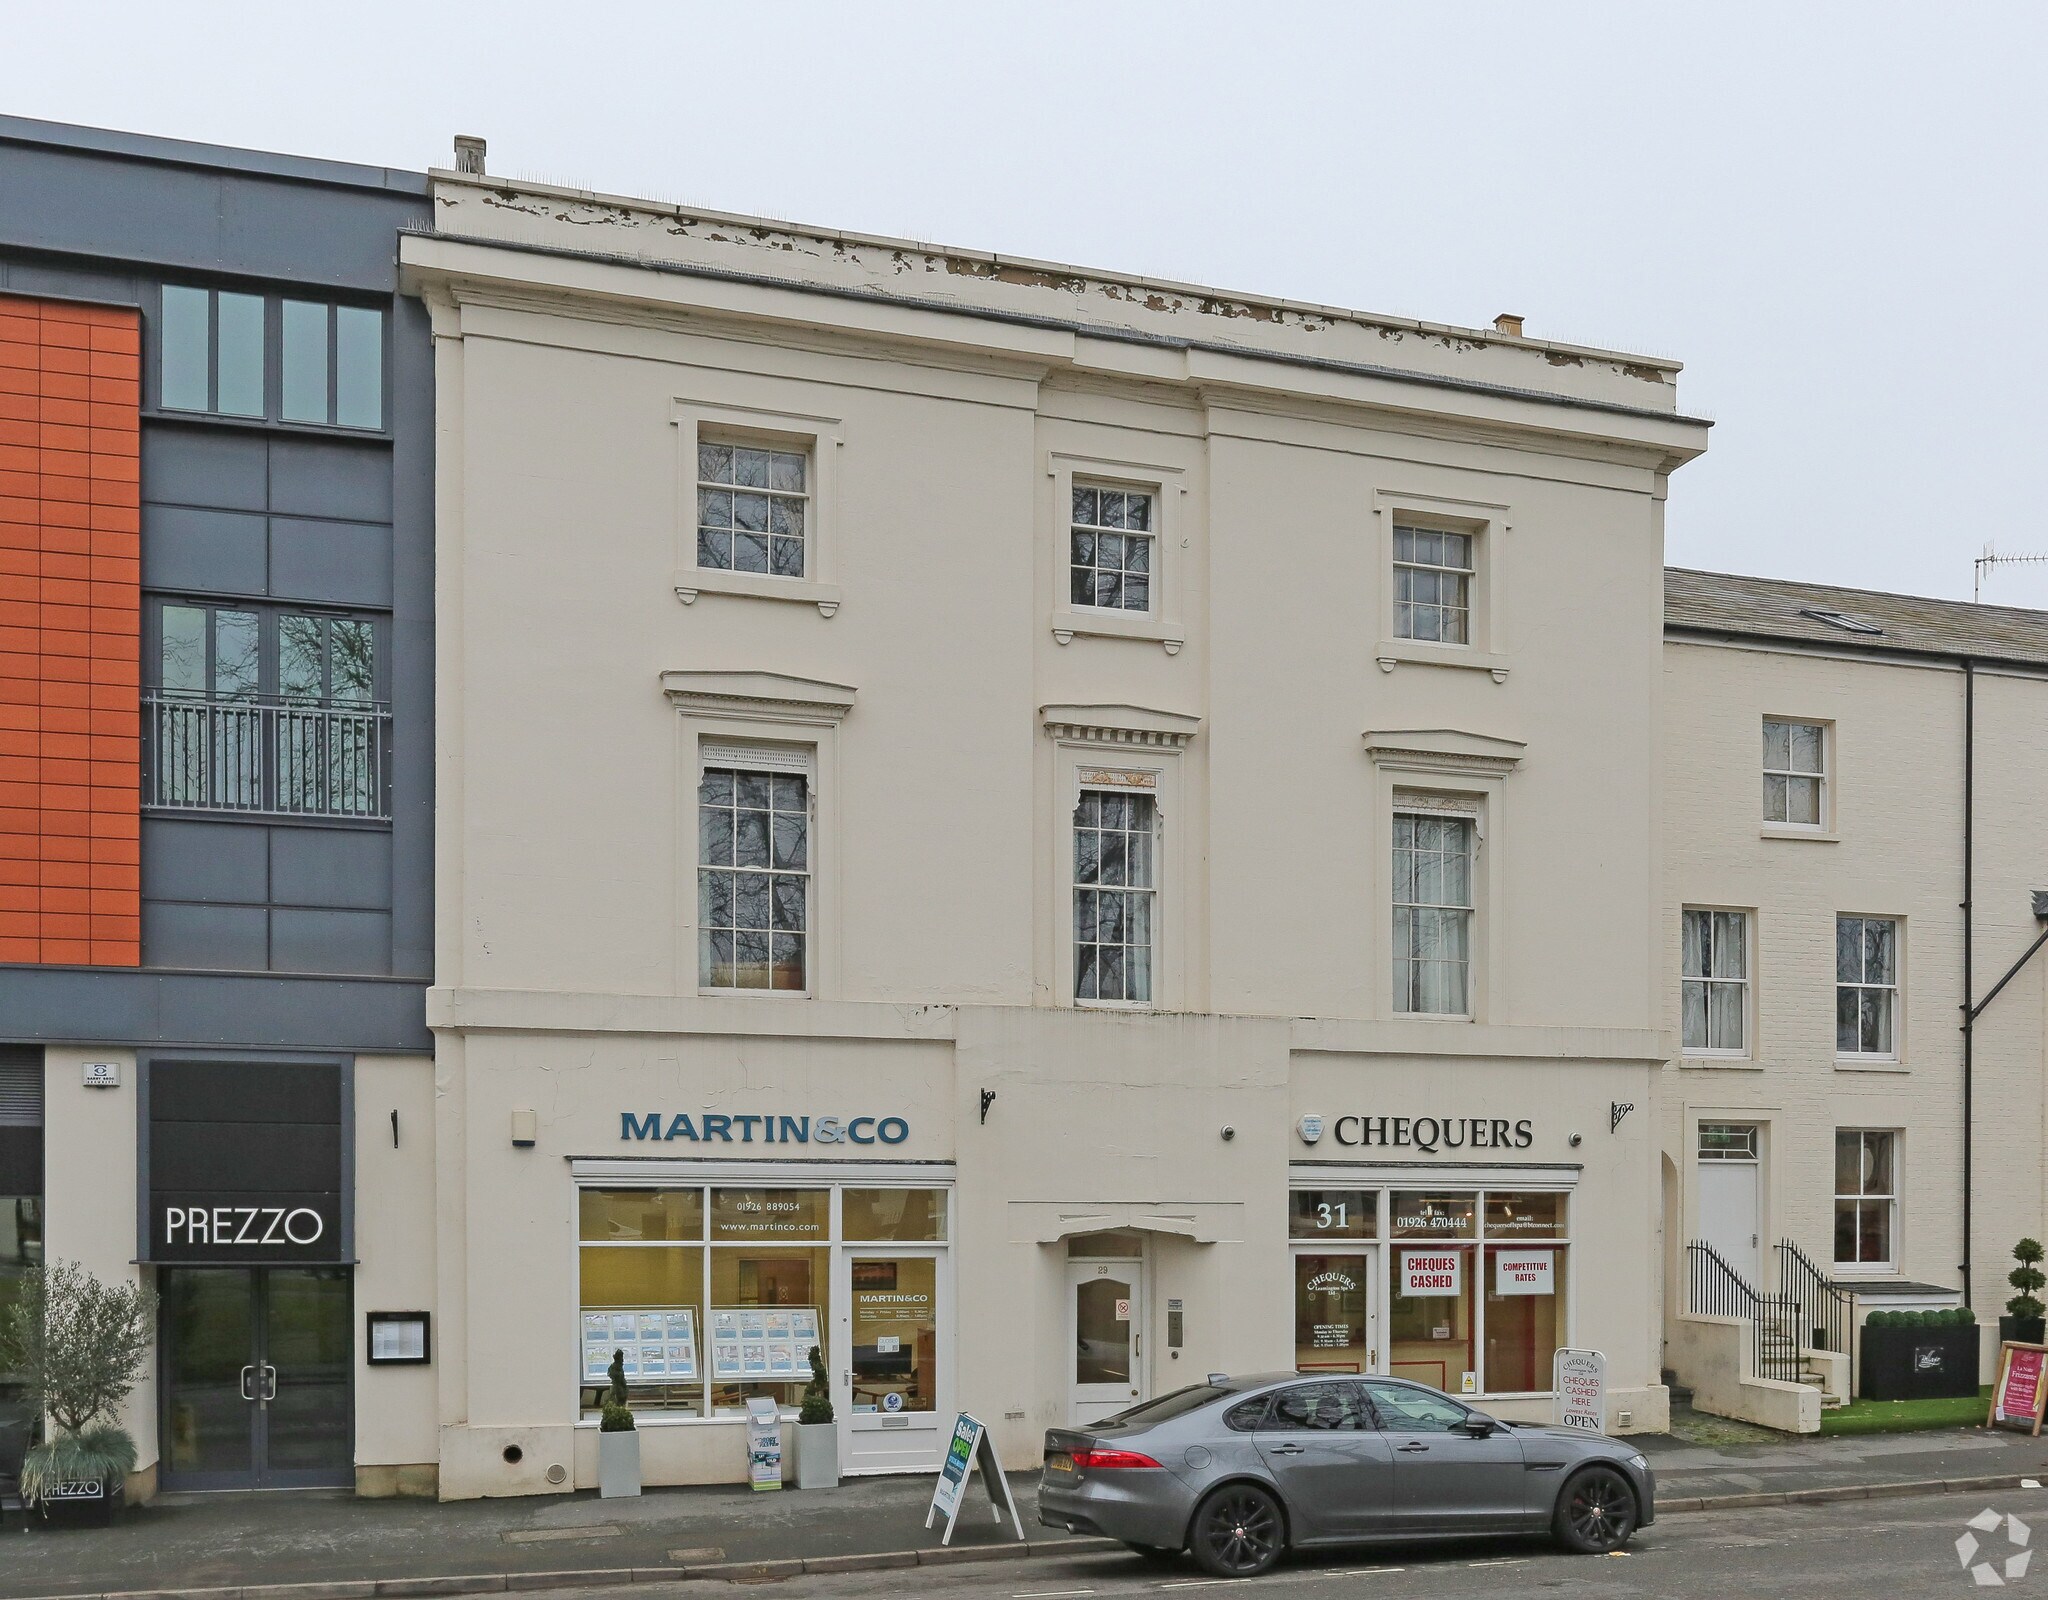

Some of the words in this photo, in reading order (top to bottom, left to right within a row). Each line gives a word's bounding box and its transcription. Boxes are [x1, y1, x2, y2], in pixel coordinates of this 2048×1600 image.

[620, 1112, 910, 1145] MARTIN&CO
[1334, 1115, 1534, 1153] CHEQUERS
[737, 1202, 761, 1211] 01926
[766, 1202, 800, 1211] 889054
[1316, 1202, 1350, 1229] 31
[1397, 1217, 1427, 1228] 01926
[1430, 1217, 1467, 1228] 470444
[166, 1207, 323, 1245] PREZZO
[720, 1222, 820, 1231] www.martinco.com
[1098, 1265, 1108, 1275] 29
[1407, 1257, 1455, 1272] CHEQUES
[1503, 1262, 1547, 1272] COMPETITIVE
[1307, 1272, 1356, 1291] CHEQUERS
[1410, 1275, 1453, 1288] CASHED
[1515, 1273, 1536, 1282] RATES
[860, 1294, 928, 1303] MARTIN&CO
[1563, 1358, 1599, 1374] CHEQUERS
[1563, 1375, 1600, 1387] CHEQUES
[1565, 1386, 1598, 1397] CASHED
[1571, 1397, 1591, 1407] HERE
[1564, 1414, 1599, 1429] OPEN
[956, 1421, 975, 1444] Sales
[952, 1437, 971, 1460] OPEN
[44, 1481, 100, 1496] PREZZO
